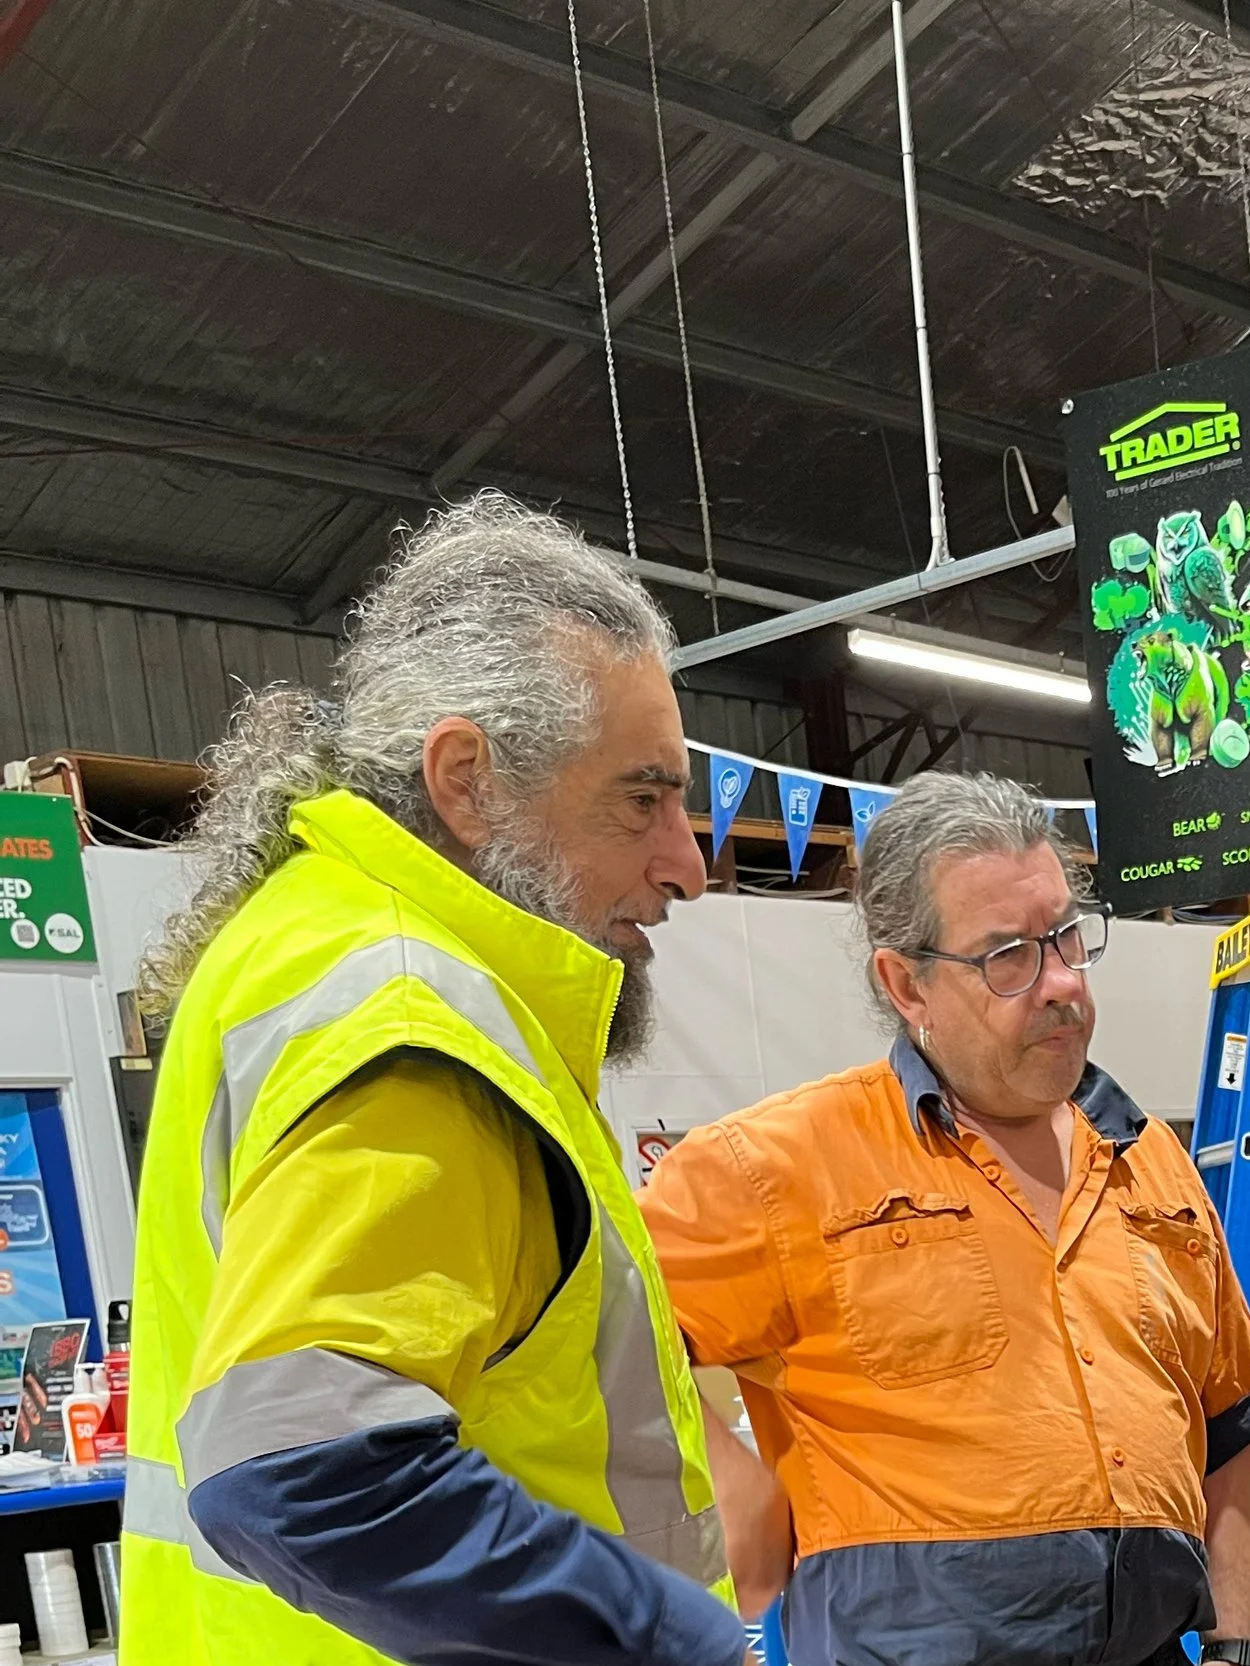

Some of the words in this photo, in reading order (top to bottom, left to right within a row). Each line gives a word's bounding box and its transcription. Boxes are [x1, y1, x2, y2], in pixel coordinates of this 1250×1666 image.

[1099, 412, 1240, 471] TRADER
[1172, 818, 1206, 837] BEAR
[1120, 861, 1175, 883] COUGAR
[57, 928, 81, 938] SAL
